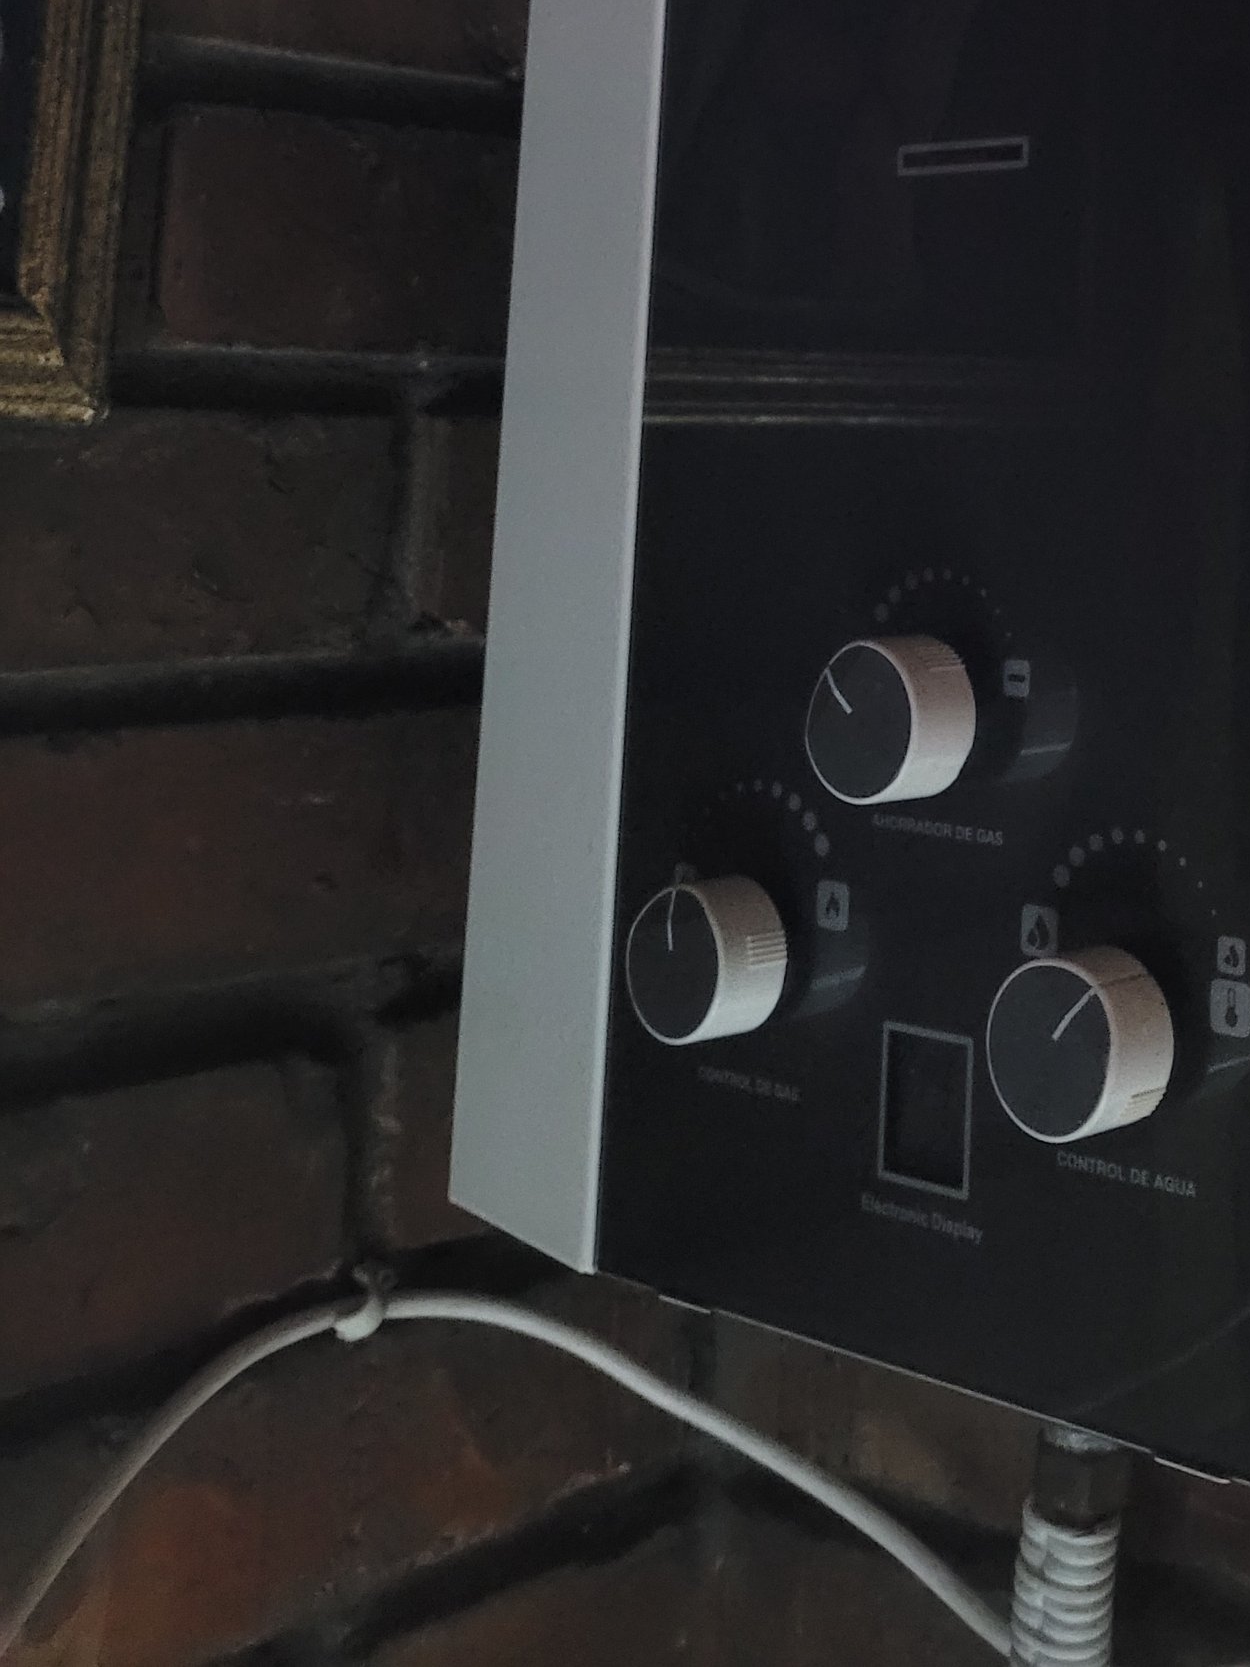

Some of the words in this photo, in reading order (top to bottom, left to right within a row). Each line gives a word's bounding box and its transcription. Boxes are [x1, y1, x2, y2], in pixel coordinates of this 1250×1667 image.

[1057, 1149, 1126, 1182] CONTROL
[1130, 1167, 1150, 1187] DE
[1154, 1173, 1197, 1197] AGUA
